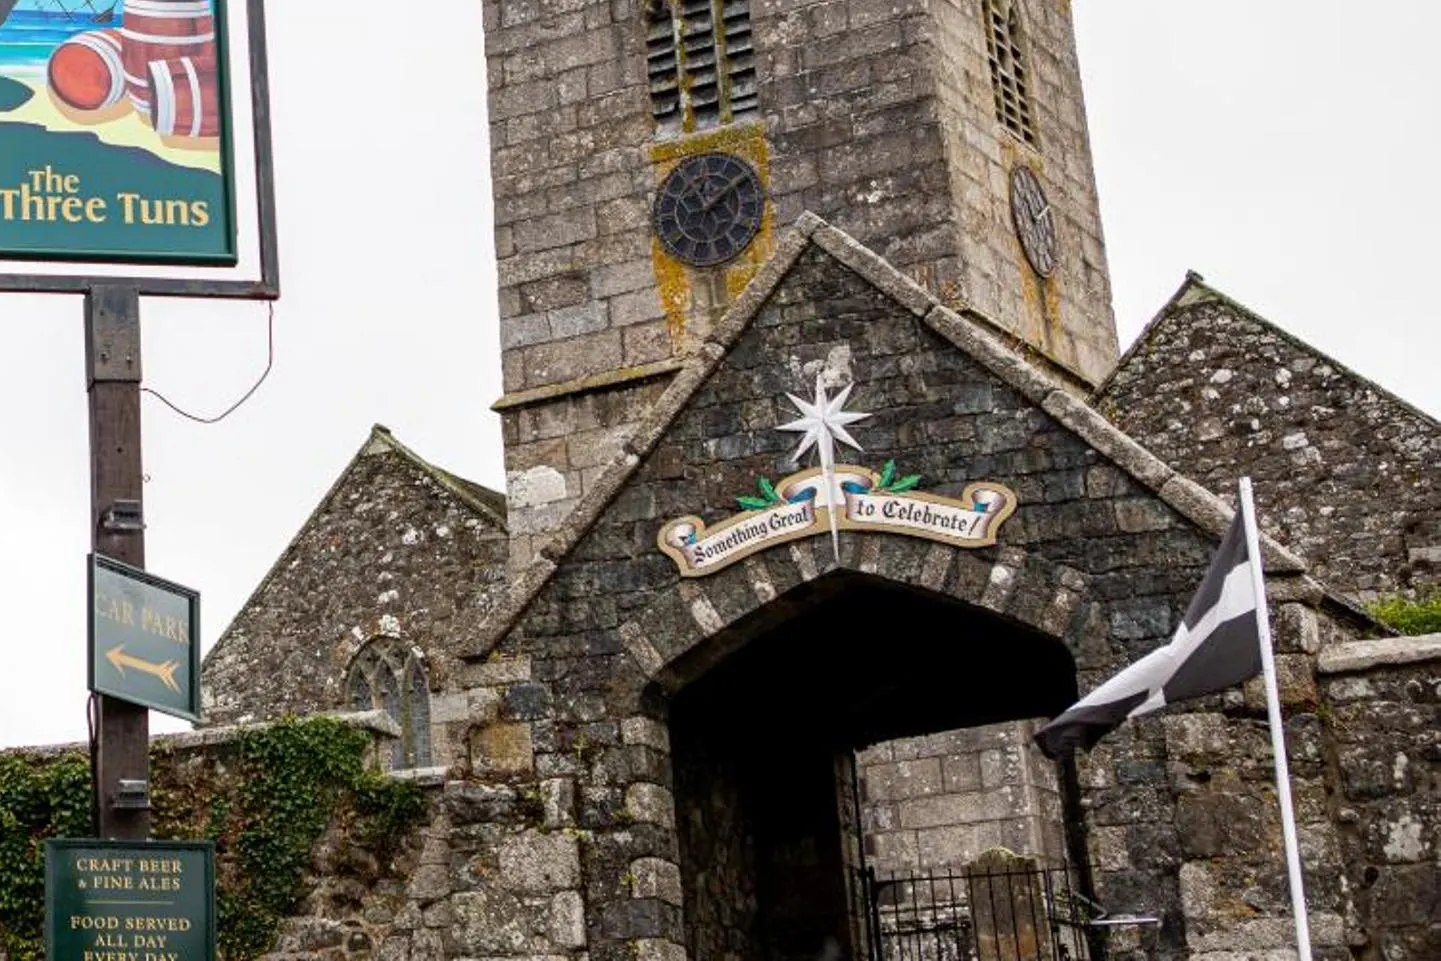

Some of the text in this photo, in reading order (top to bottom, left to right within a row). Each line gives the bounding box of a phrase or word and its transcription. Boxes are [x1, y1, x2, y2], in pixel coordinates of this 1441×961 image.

[27, 165, 80, 194] The
[116, 192, 210, 227] Tuns
[856, 499, 982, 536] to Celebrate!
[693, 506, 809, 563] Something Great
[95, 592, 191, 645] CAR PARK
[76, 858, 183, 874] CRAFT BEER
[78, 876, 181, 890] & FINE ALES
[70, 915, 192, 932] FOOD SERVED
[95, 933, 168, 949] ALL DAY
